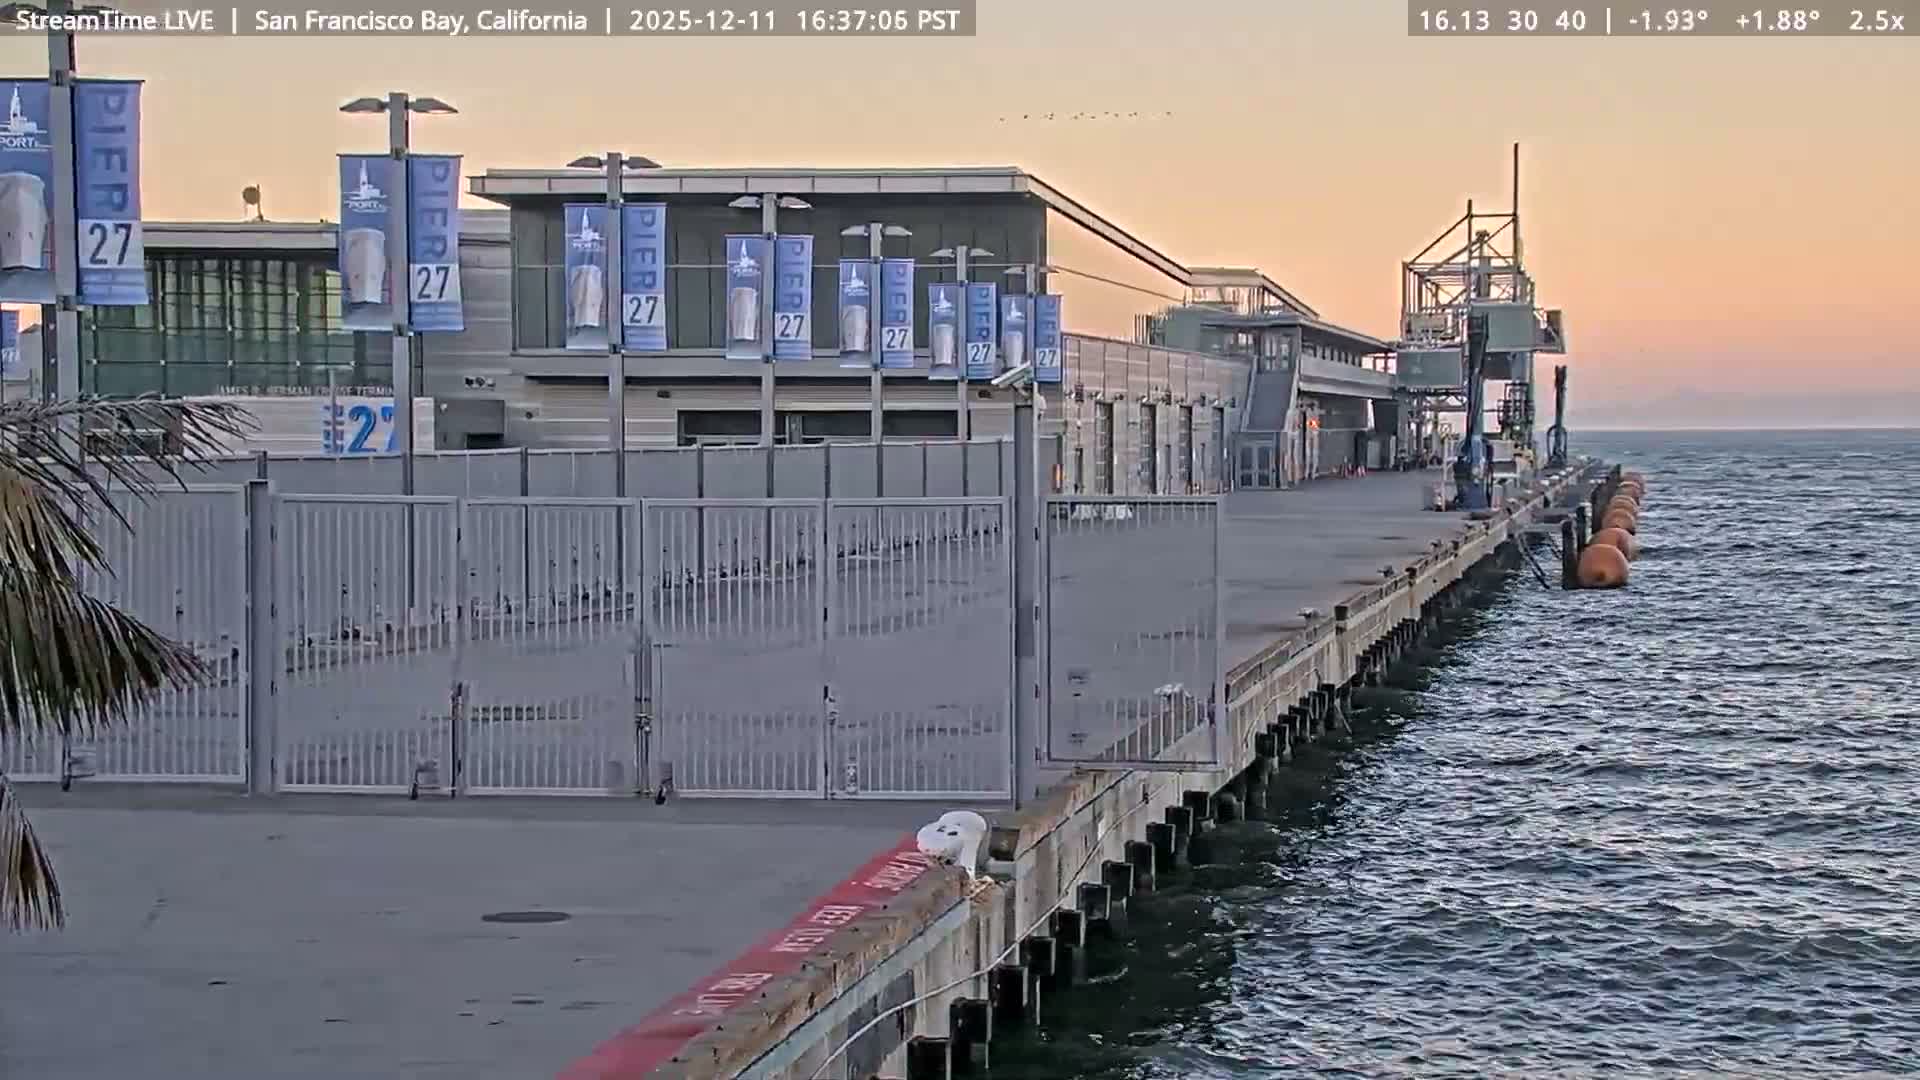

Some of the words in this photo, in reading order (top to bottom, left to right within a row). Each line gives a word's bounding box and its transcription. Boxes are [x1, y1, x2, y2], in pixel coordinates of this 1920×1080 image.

[88, 87, 130, 213] PIER
[413, 160, 450, 259] PIER
[88, 223, 132, 266] 27
[632, 209, 657, 290] PIER
[417, 266, 450, 300] 27
[784, 241, 804, 309] PIER
[629, 296, 658, 324] 27
[779, 314, 805, 338] 27
[886, 328, 908, 349] 27
[971, 343, 991, 362] 27
[1039, 350, 1057, 366] 27
[348, 405, 398, 453] 27
